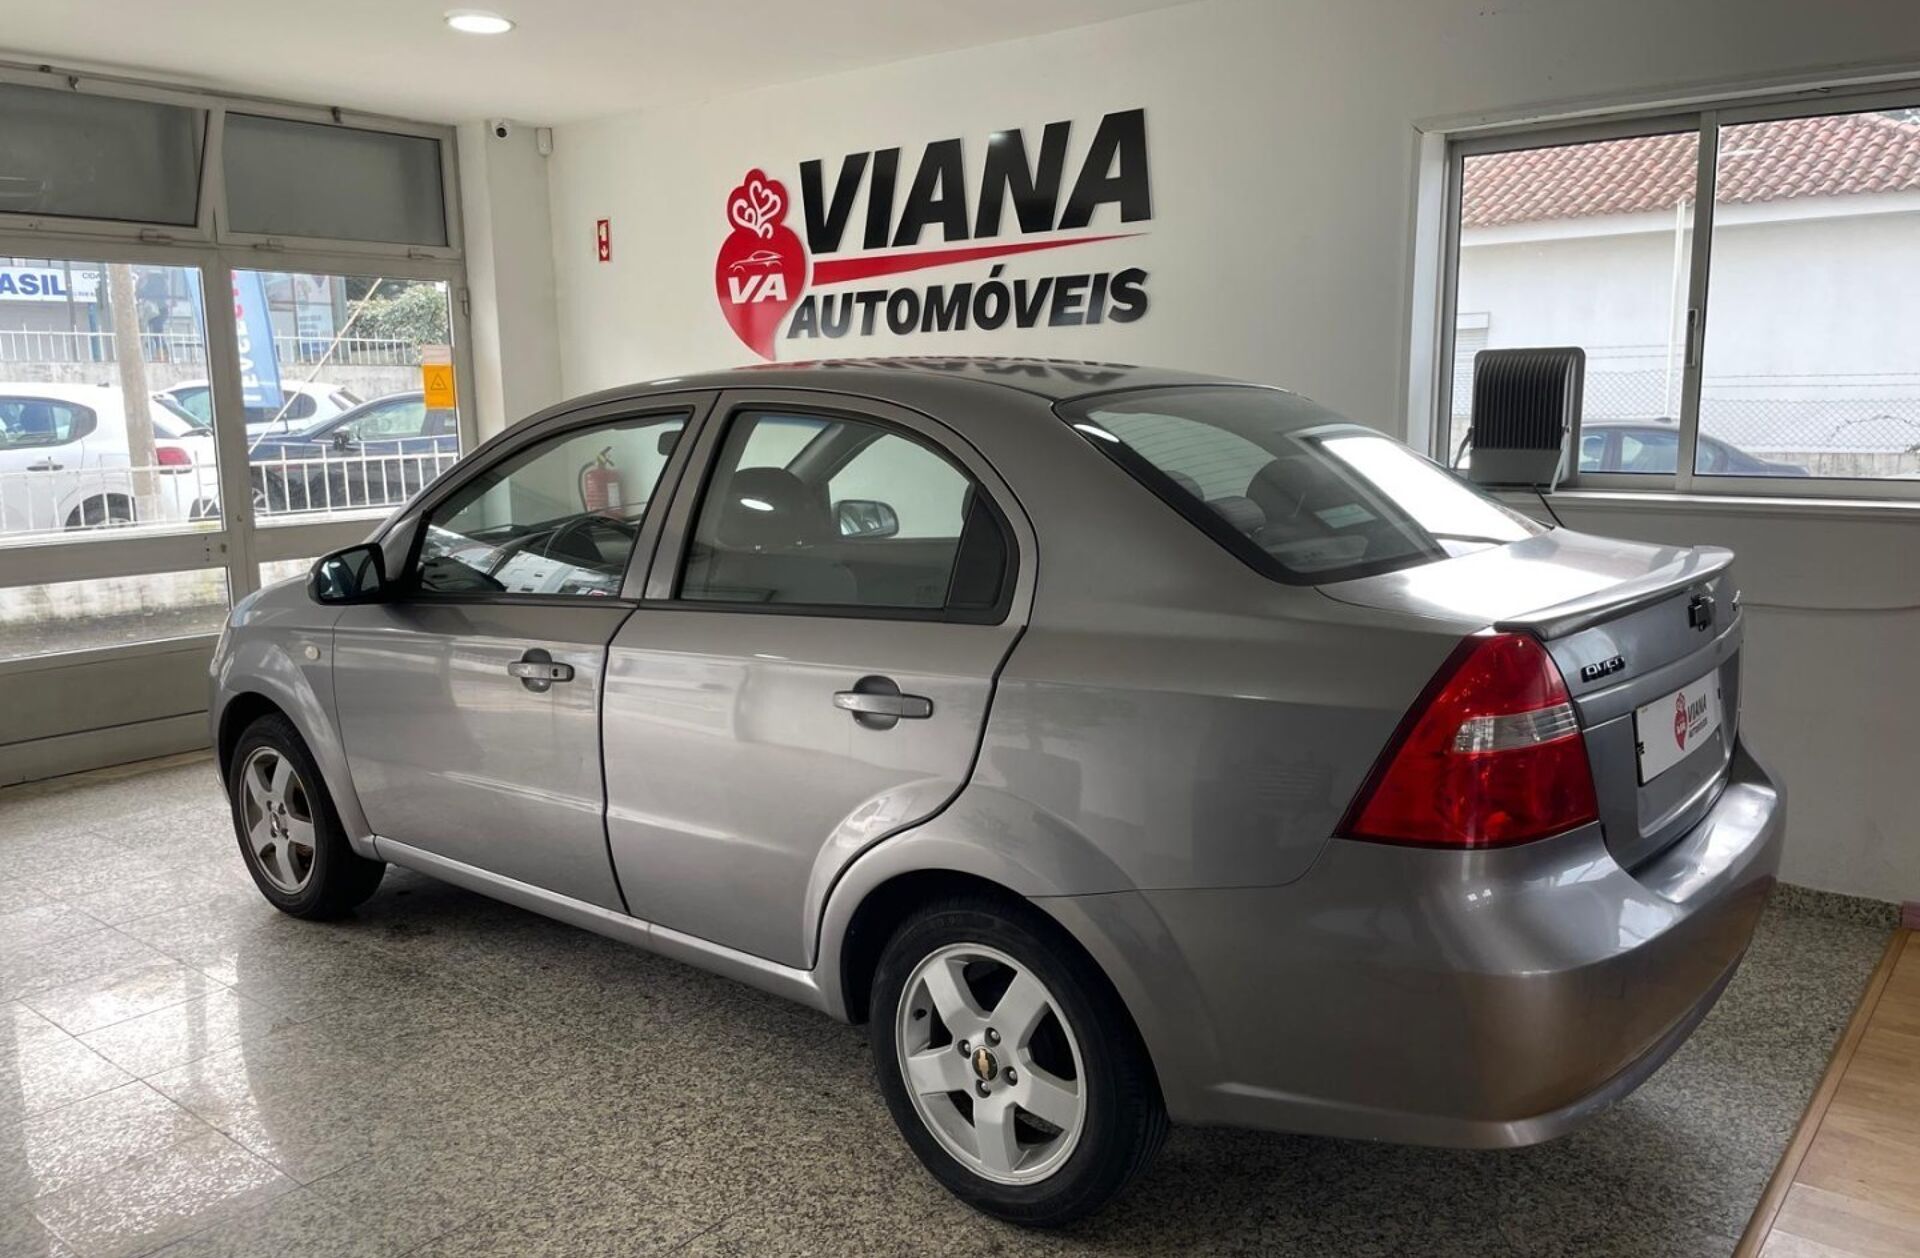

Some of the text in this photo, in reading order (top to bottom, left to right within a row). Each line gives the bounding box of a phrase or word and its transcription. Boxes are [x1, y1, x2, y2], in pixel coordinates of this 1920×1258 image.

[799, 108, 1153, 255] VIANA
[727, 272, 788, 305] VA
[787, 264, 1149, 339] AUTOMÓVEIS
